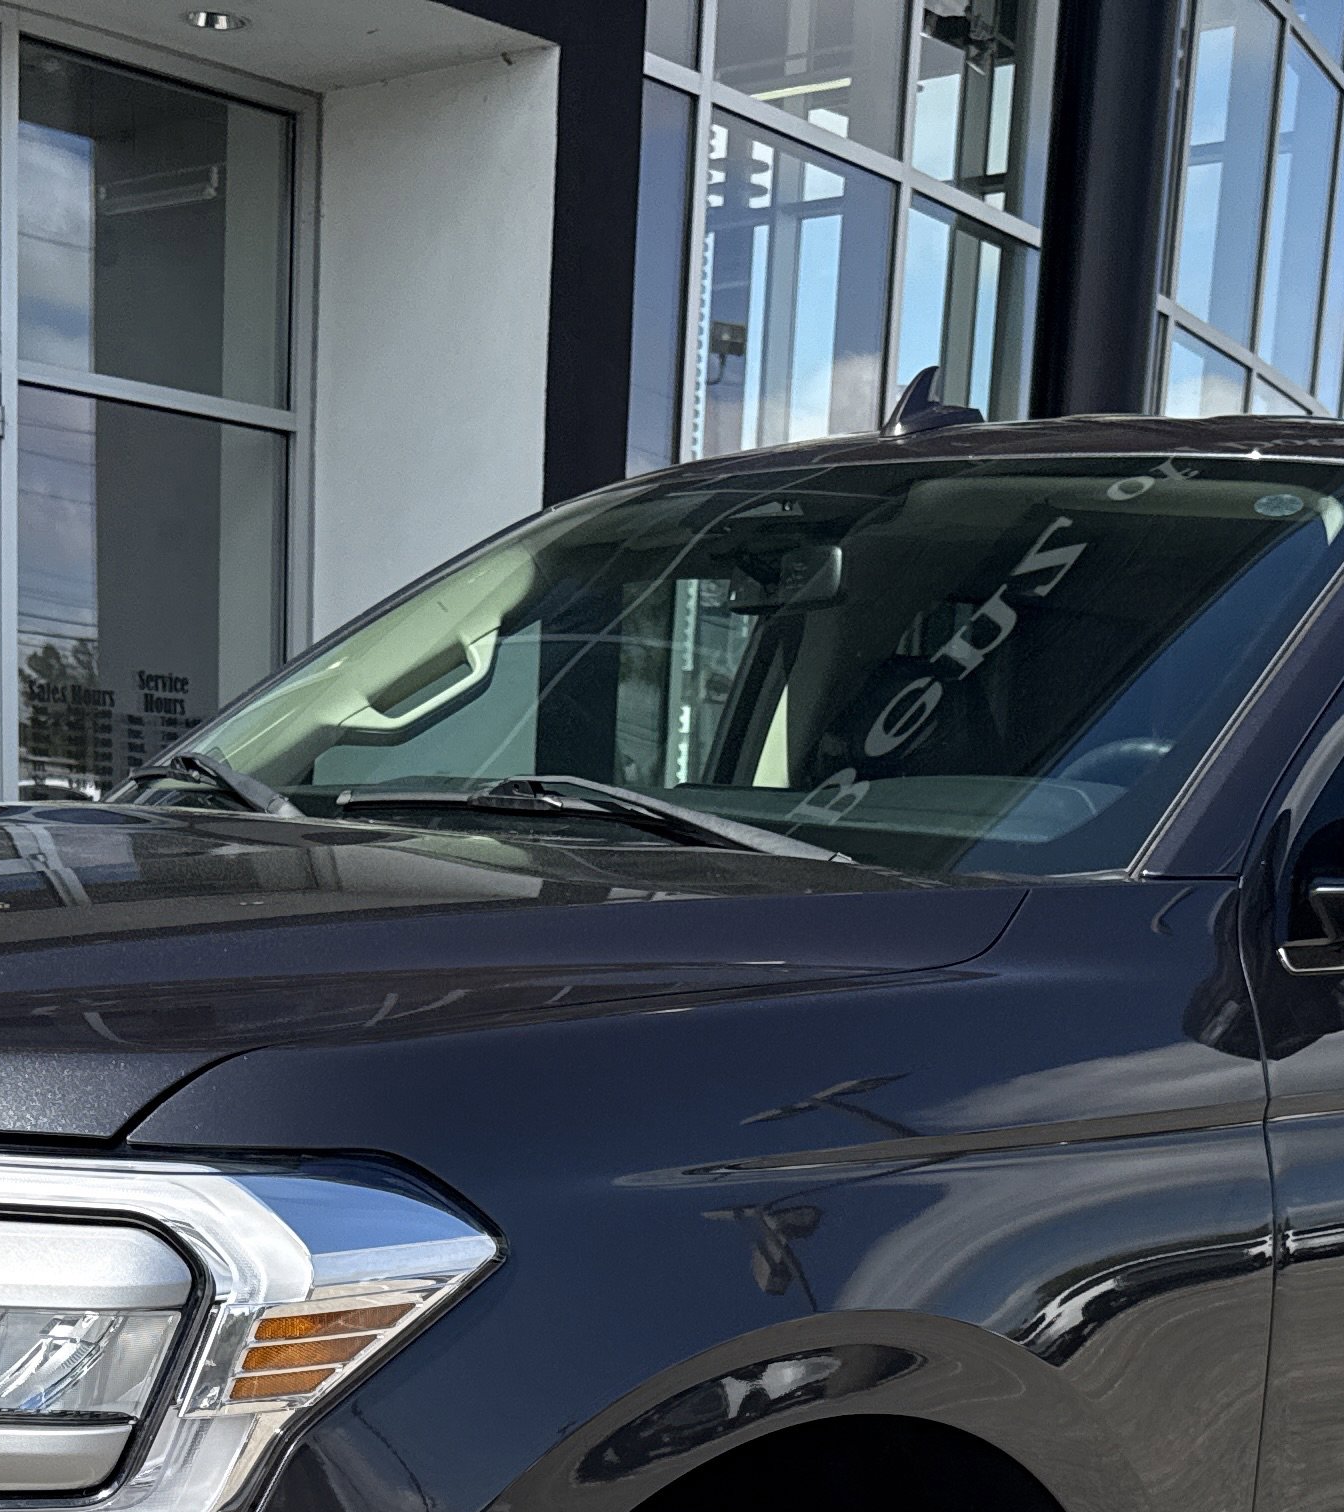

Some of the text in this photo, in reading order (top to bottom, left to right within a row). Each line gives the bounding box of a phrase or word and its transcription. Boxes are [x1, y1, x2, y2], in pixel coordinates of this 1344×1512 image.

[28, 679, 116, 707] Sales Hours
[138, 670, 190, 694] Service
[143, 693, 186, 715] Hours
